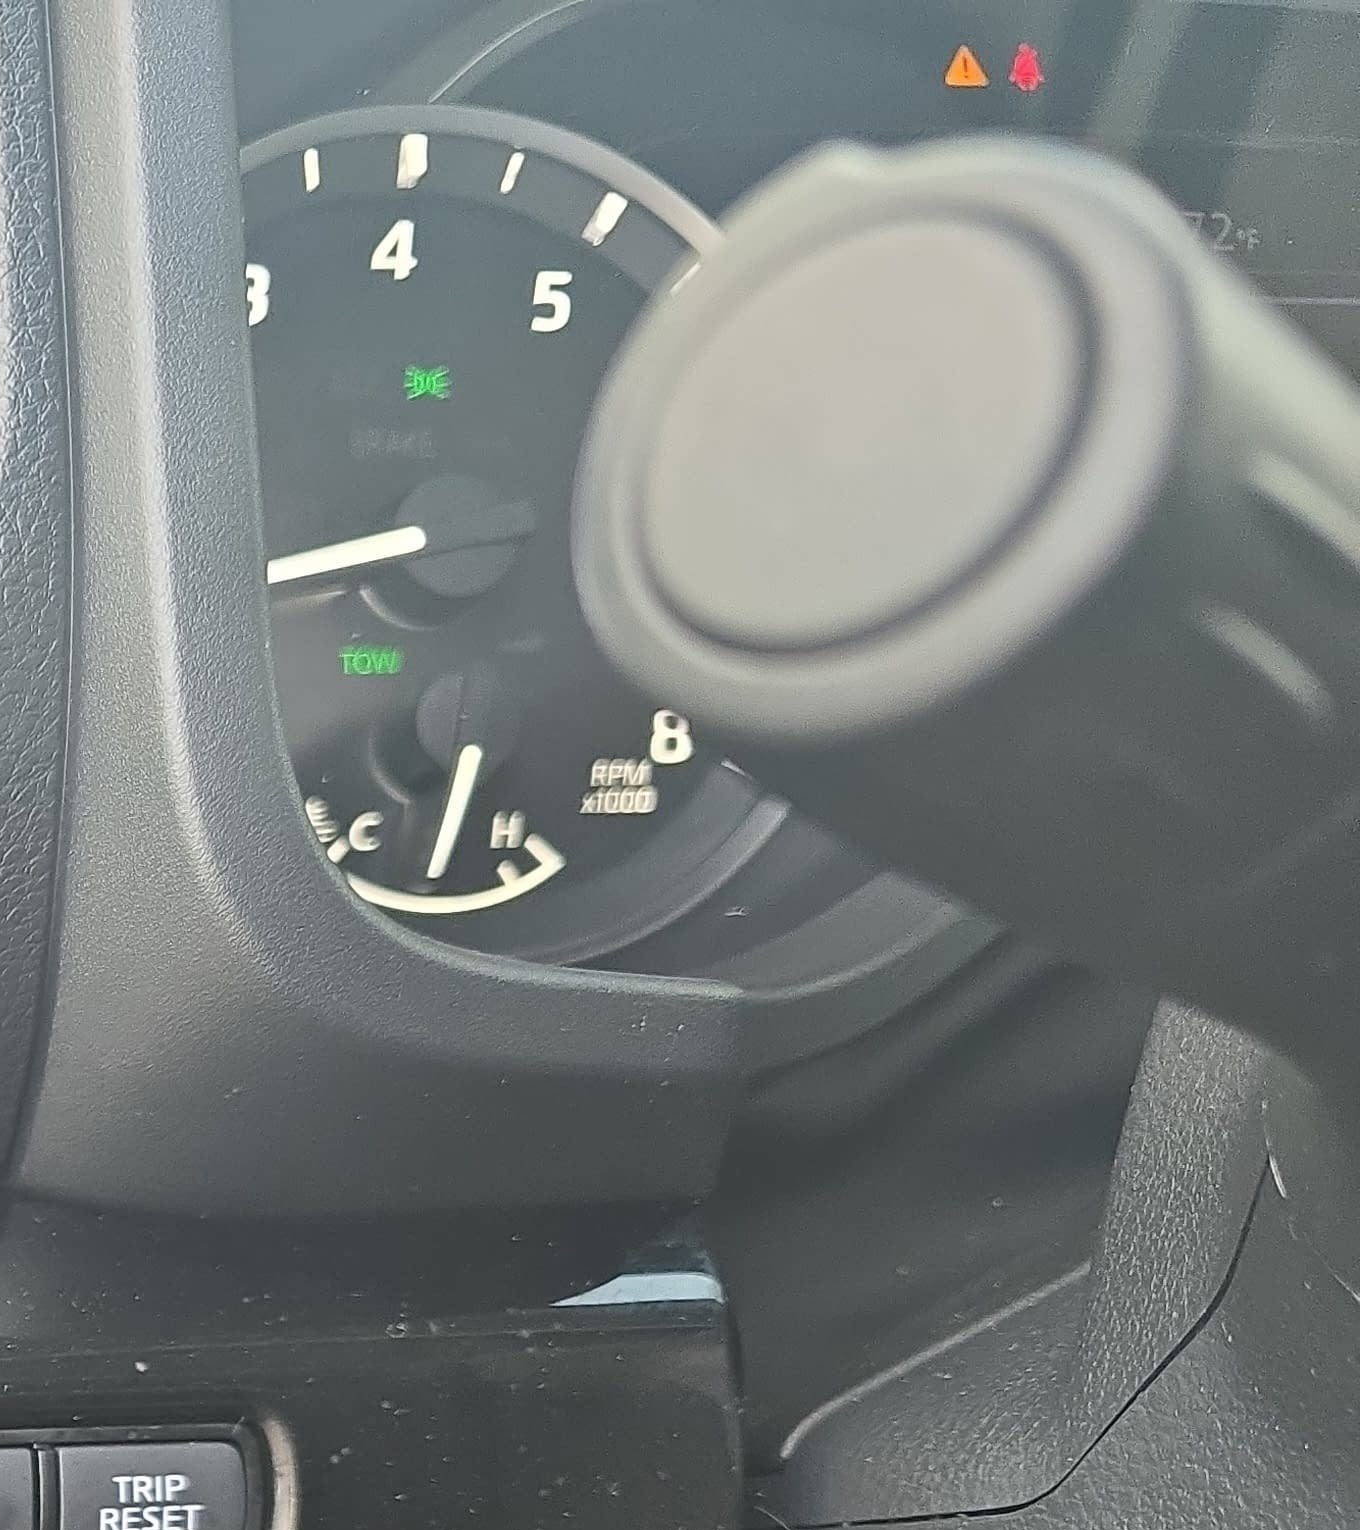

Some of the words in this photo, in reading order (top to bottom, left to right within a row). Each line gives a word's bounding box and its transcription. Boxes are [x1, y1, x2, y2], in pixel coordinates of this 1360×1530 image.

[370, 219, 418, 280] 4
[530, 270, 573, 332] 5
[338, 646, 403, 675] TOW
[650, 709, 692, 764] 8
[590, 758, 653, 787] RPM
[348, 810, 384, 852] C
[489, 810, 525, 850] H
[112, 1474, 190, 1503] TRIP
